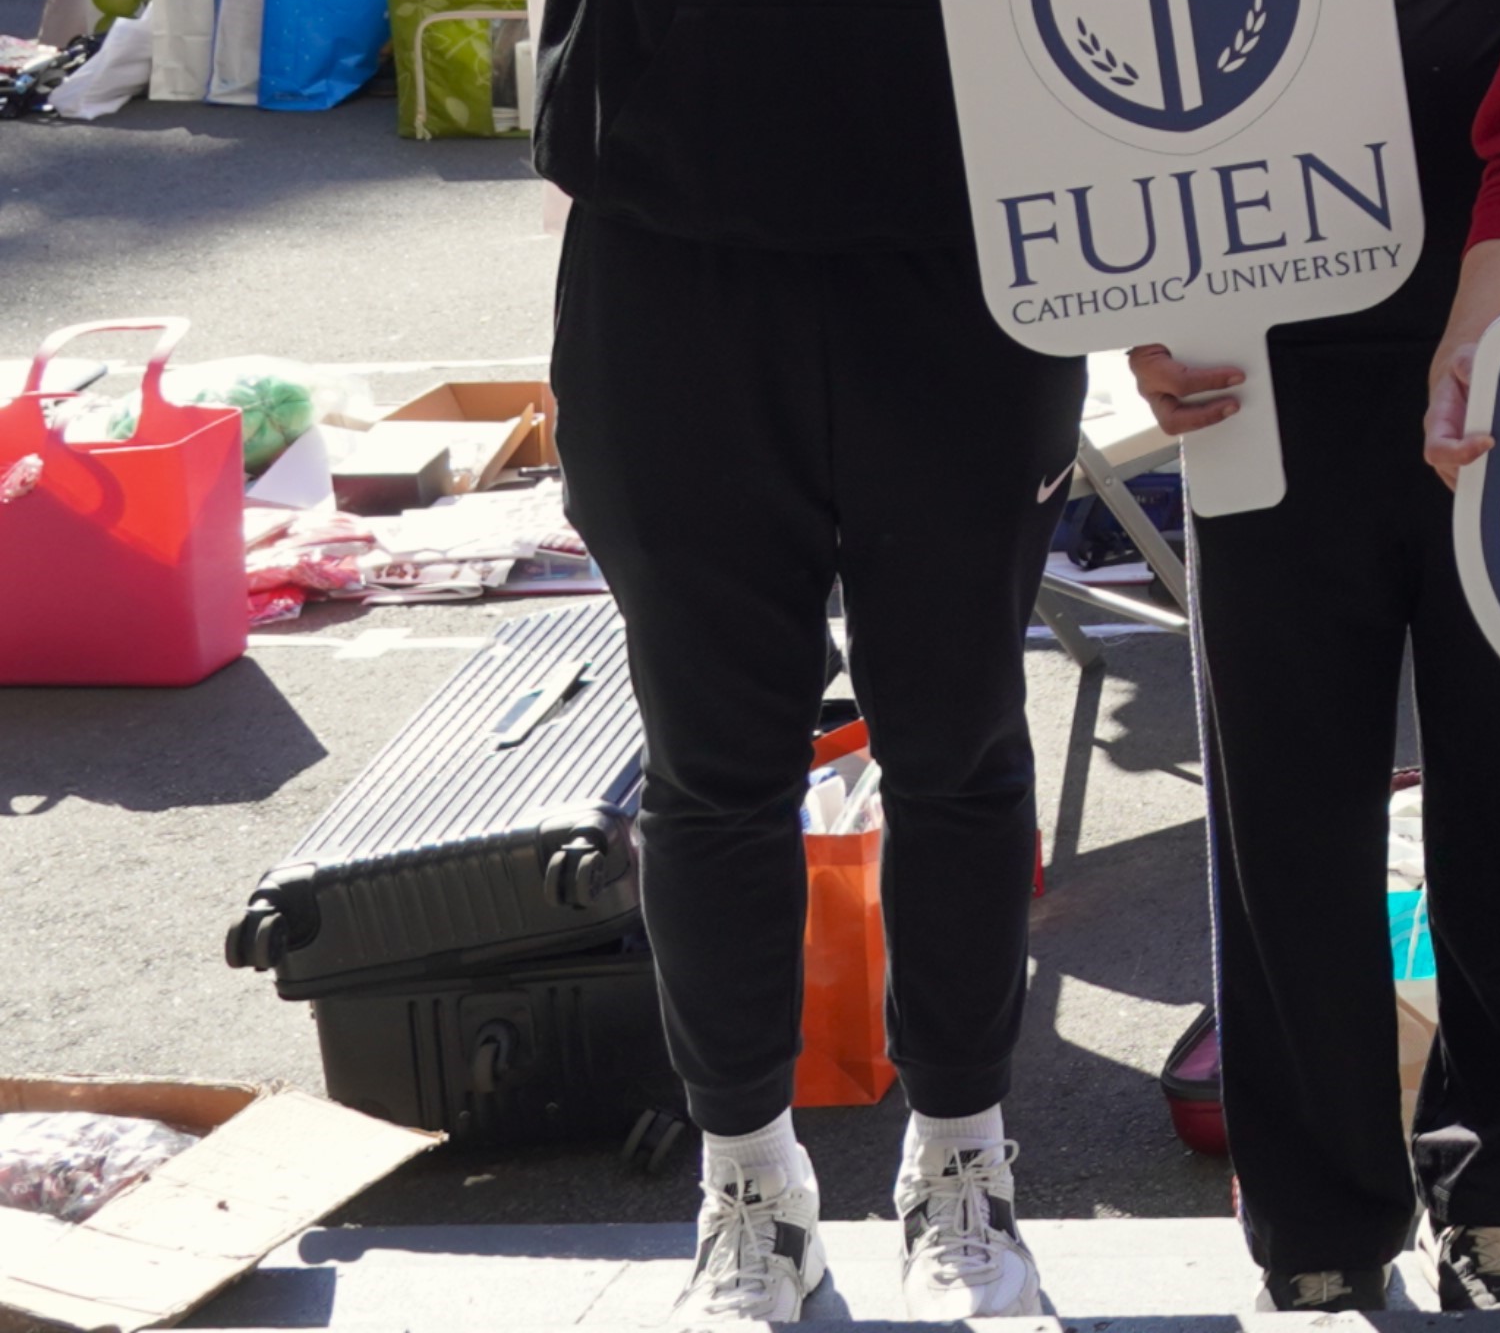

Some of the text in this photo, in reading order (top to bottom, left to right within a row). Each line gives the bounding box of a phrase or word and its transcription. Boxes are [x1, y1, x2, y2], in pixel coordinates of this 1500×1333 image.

[996, 140, 1394, 291] FUJEN
[1011, 242, 1404, 326] CATHOLIC UNIVERSITY
